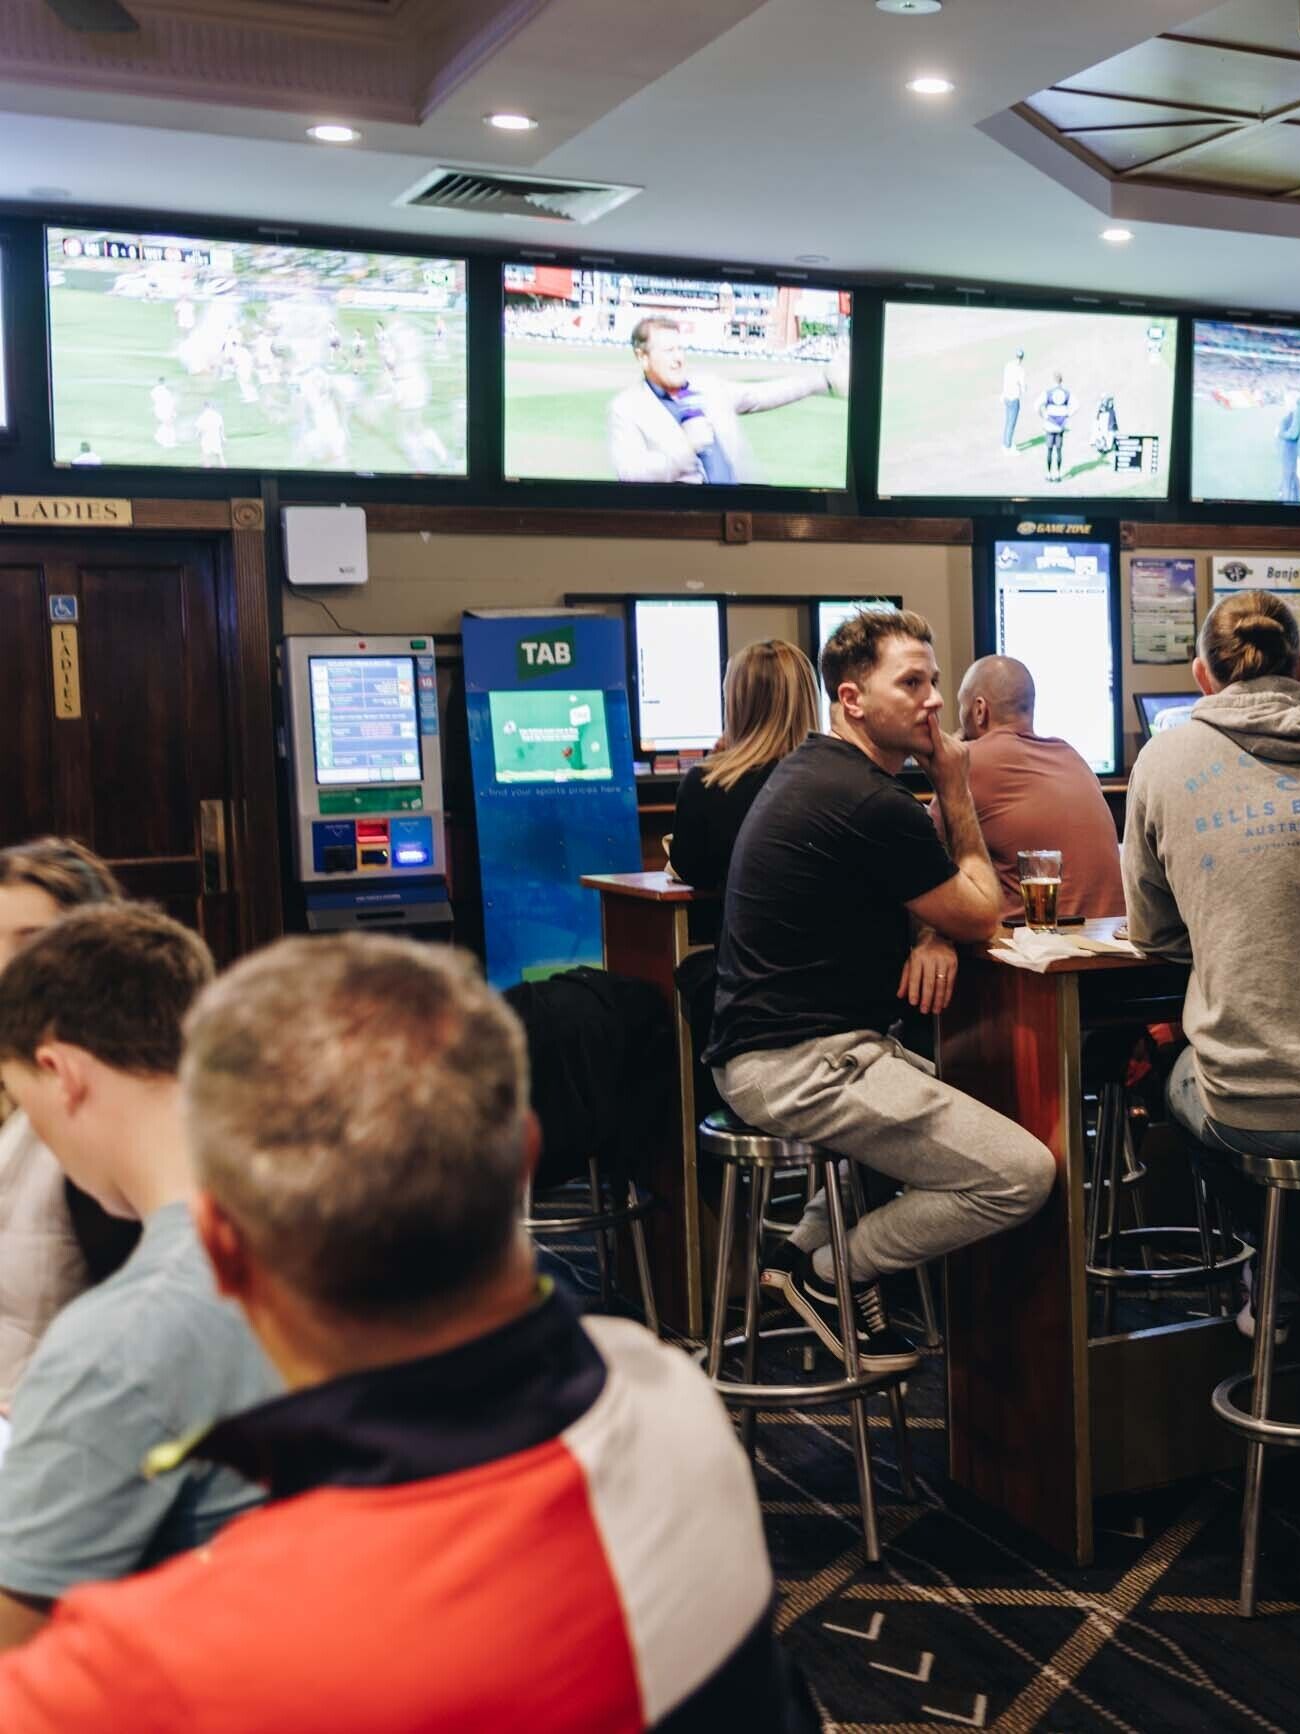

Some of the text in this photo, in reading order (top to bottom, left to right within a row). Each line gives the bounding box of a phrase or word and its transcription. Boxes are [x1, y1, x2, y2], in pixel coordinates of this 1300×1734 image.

[14, 501, 117, 519] LADIES
[1036, 523, 1092, 534] GAME ZONE
[521, 642, 571, 664] TAB
[60, 631, 73, 713] LADIES
[600, 784, 620, 793] here
[1195, 801, 1275, 833] BELLS
